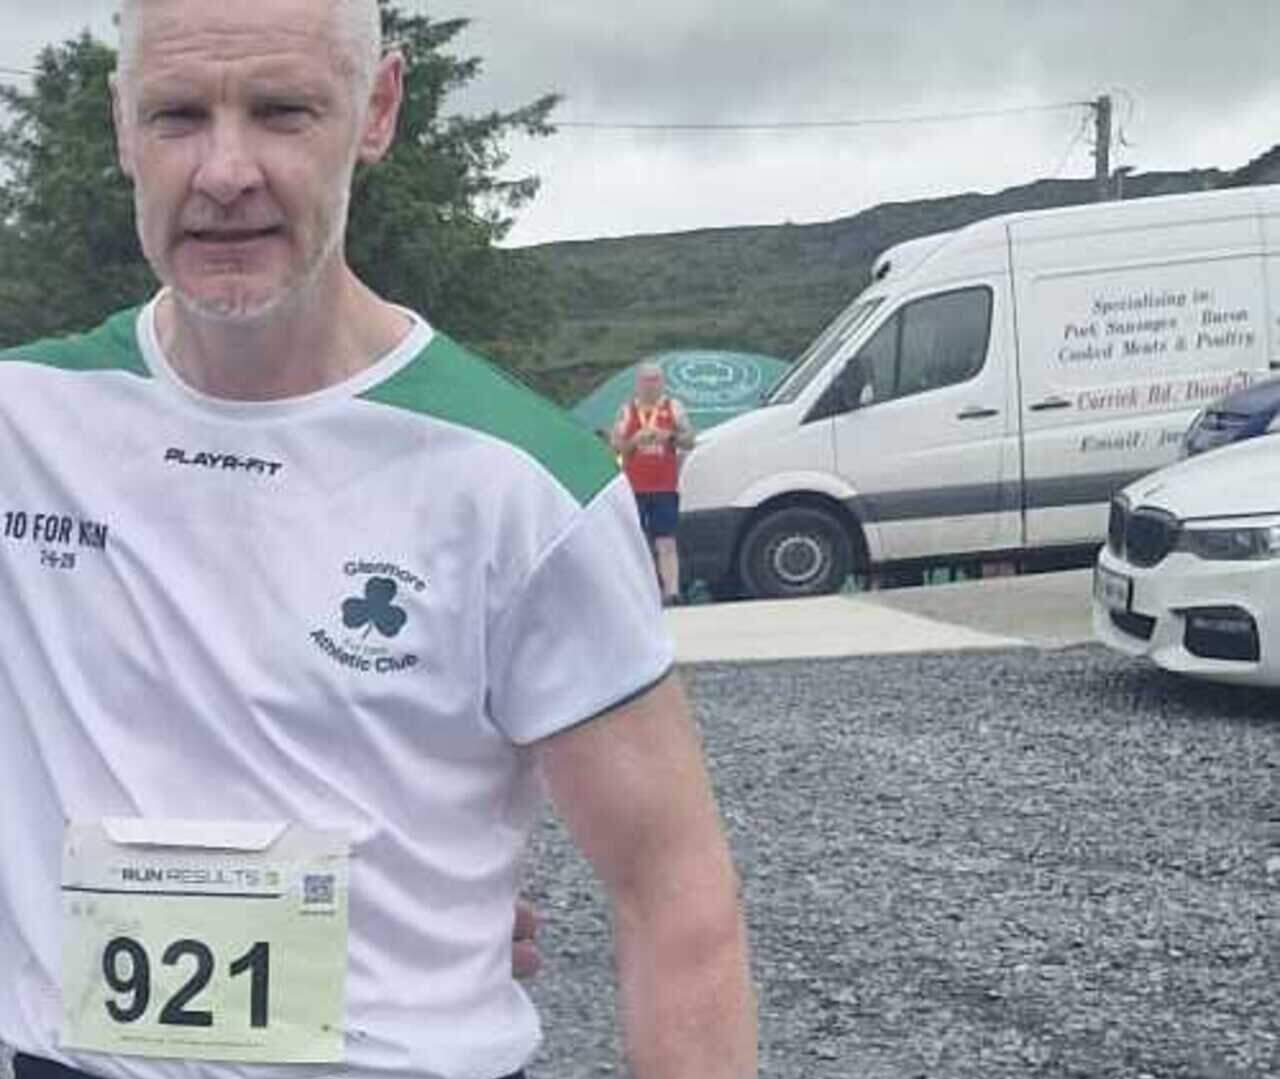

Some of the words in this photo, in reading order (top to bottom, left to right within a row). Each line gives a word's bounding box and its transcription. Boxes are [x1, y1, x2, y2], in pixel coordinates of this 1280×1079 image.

[4, 511, 27, 539] 10
[33, 514, 73, 544] FOR
[374, 652, 420, 674] Club
[121, 867, 162, 881] RUN
[102, 936, 271, 1028] 921
